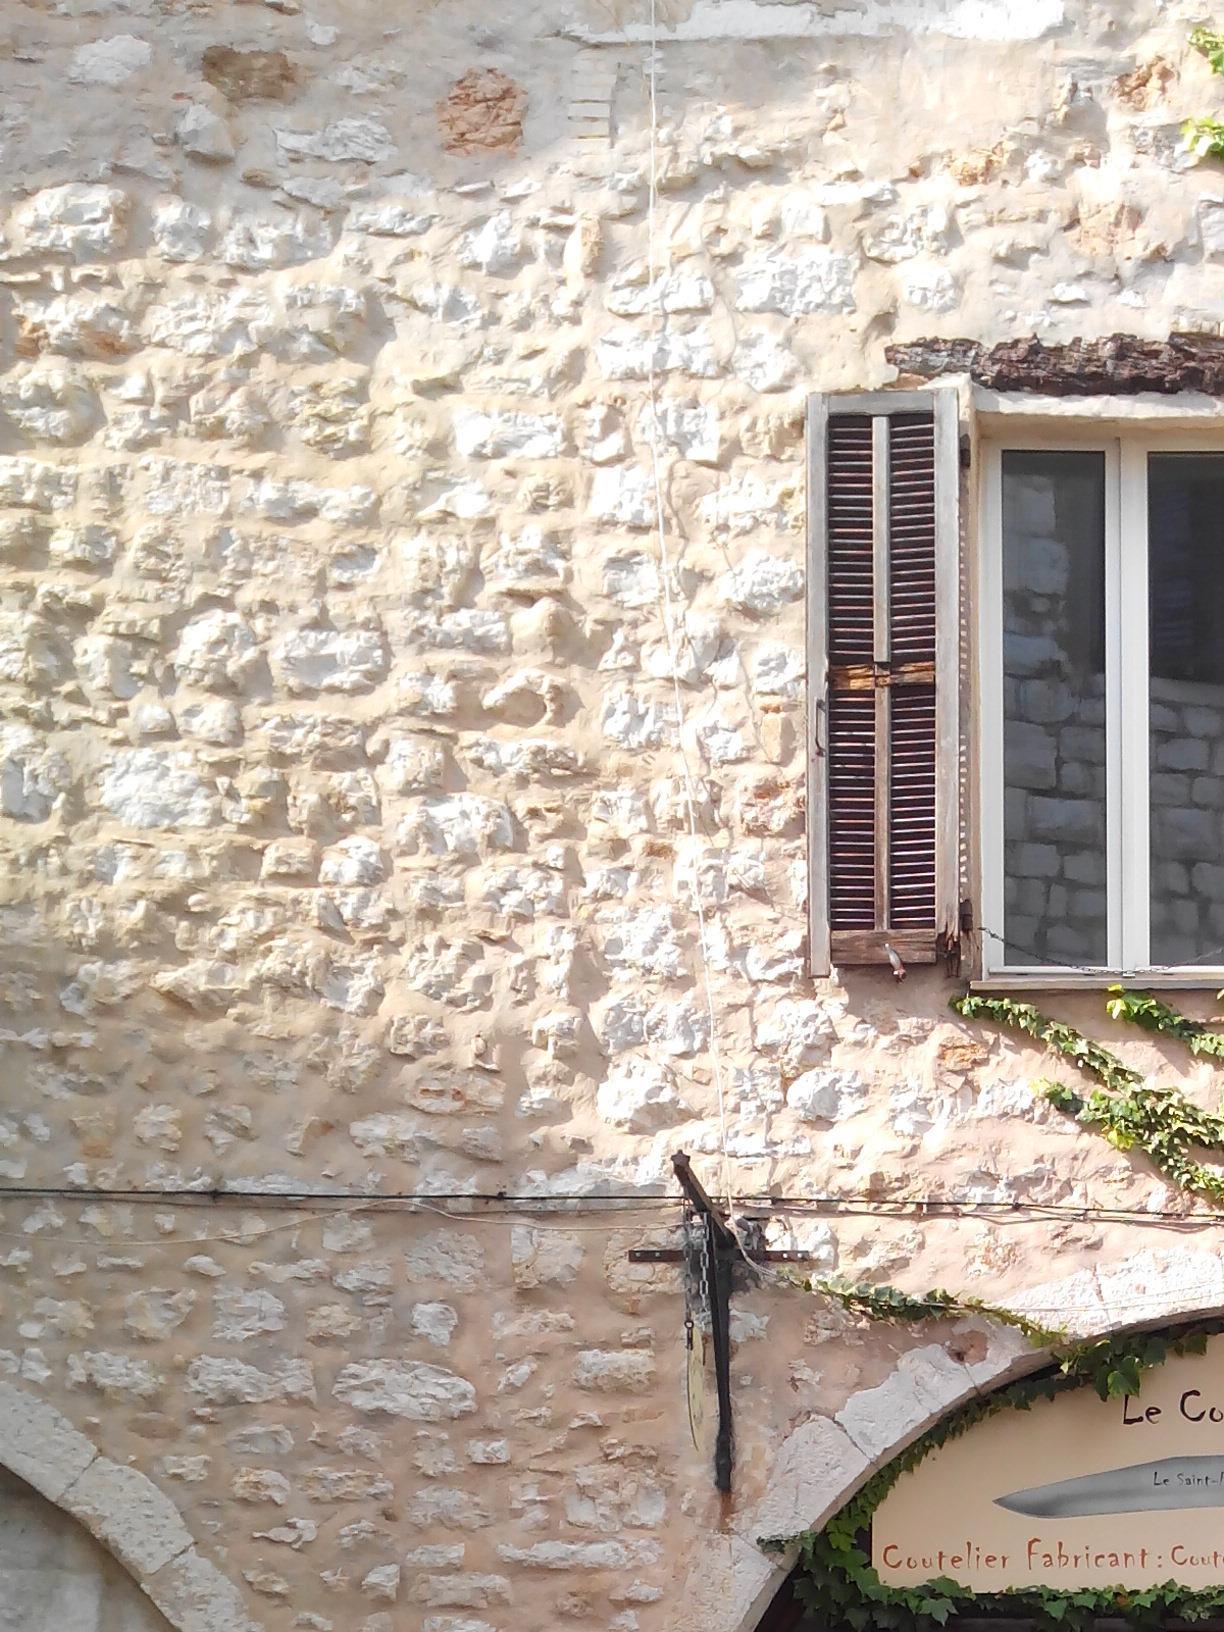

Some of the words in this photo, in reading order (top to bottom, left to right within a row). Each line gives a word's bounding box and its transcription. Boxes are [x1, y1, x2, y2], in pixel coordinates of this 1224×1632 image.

[1122, 1394, 1162, 1425] Le
[1153, 1471, 1169, 1486] Le
[882, 1541, 1009, 1569] Coutelier
